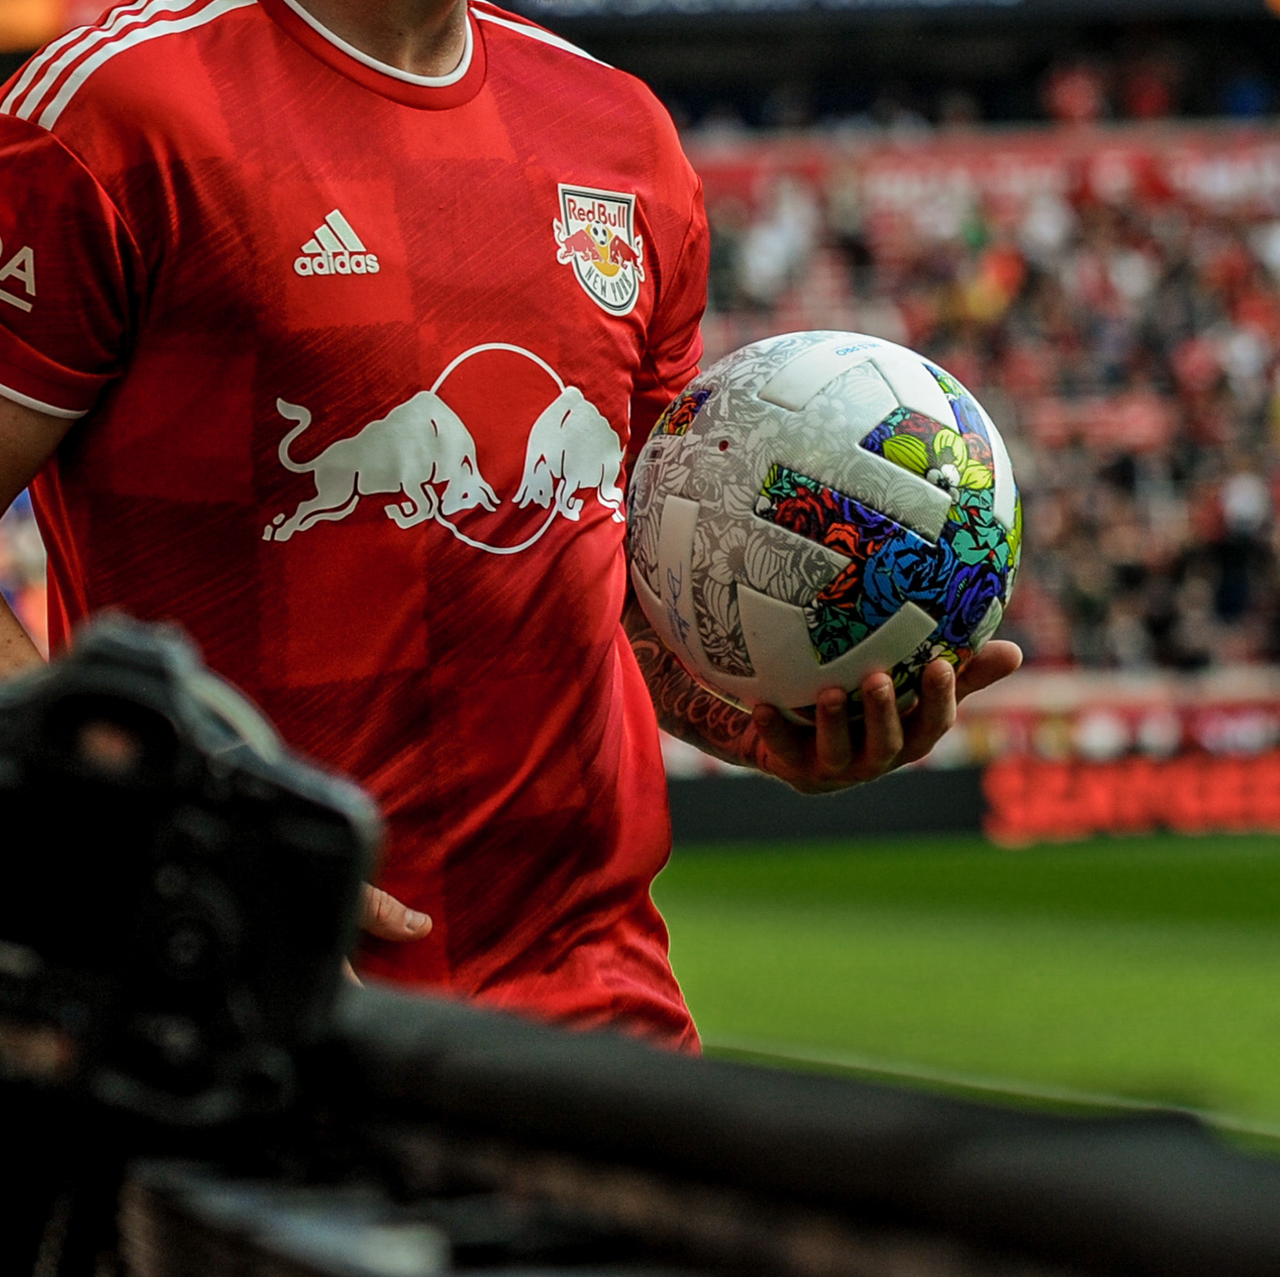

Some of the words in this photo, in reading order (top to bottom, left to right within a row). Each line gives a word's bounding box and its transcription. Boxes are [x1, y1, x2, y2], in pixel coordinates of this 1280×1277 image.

[567, 197, 596, 222] Red
[597, 203, 625, 228] Bull
[293, 250, 381, 277] adidas
[585, 266, 607, 298] NEW
[610, 272, 632, 302] YORK
